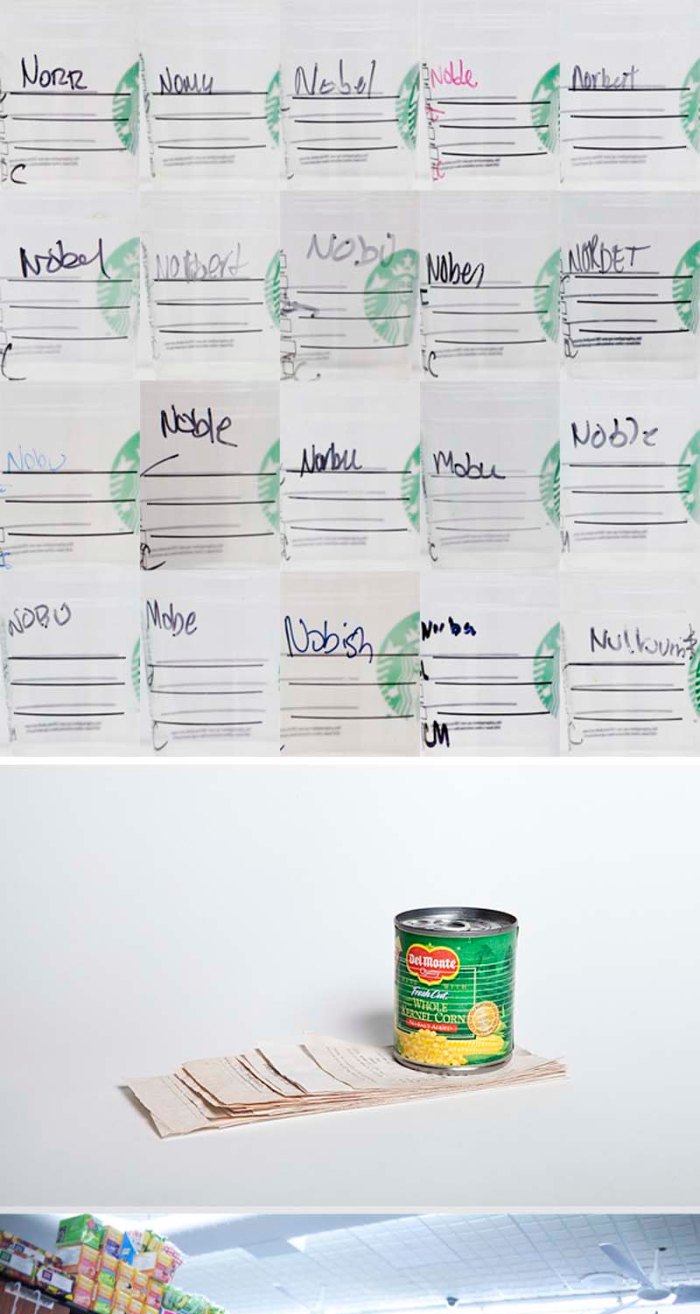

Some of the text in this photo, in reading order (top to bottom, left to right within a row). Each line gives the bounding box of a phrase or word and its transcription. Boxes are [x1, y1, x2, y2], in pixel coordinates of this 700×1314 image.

[409, 953, 457, 970] Del Monte
[413, 998, 449, 1012] WHOLE
[434, 1011, 467, 1024] CORN
